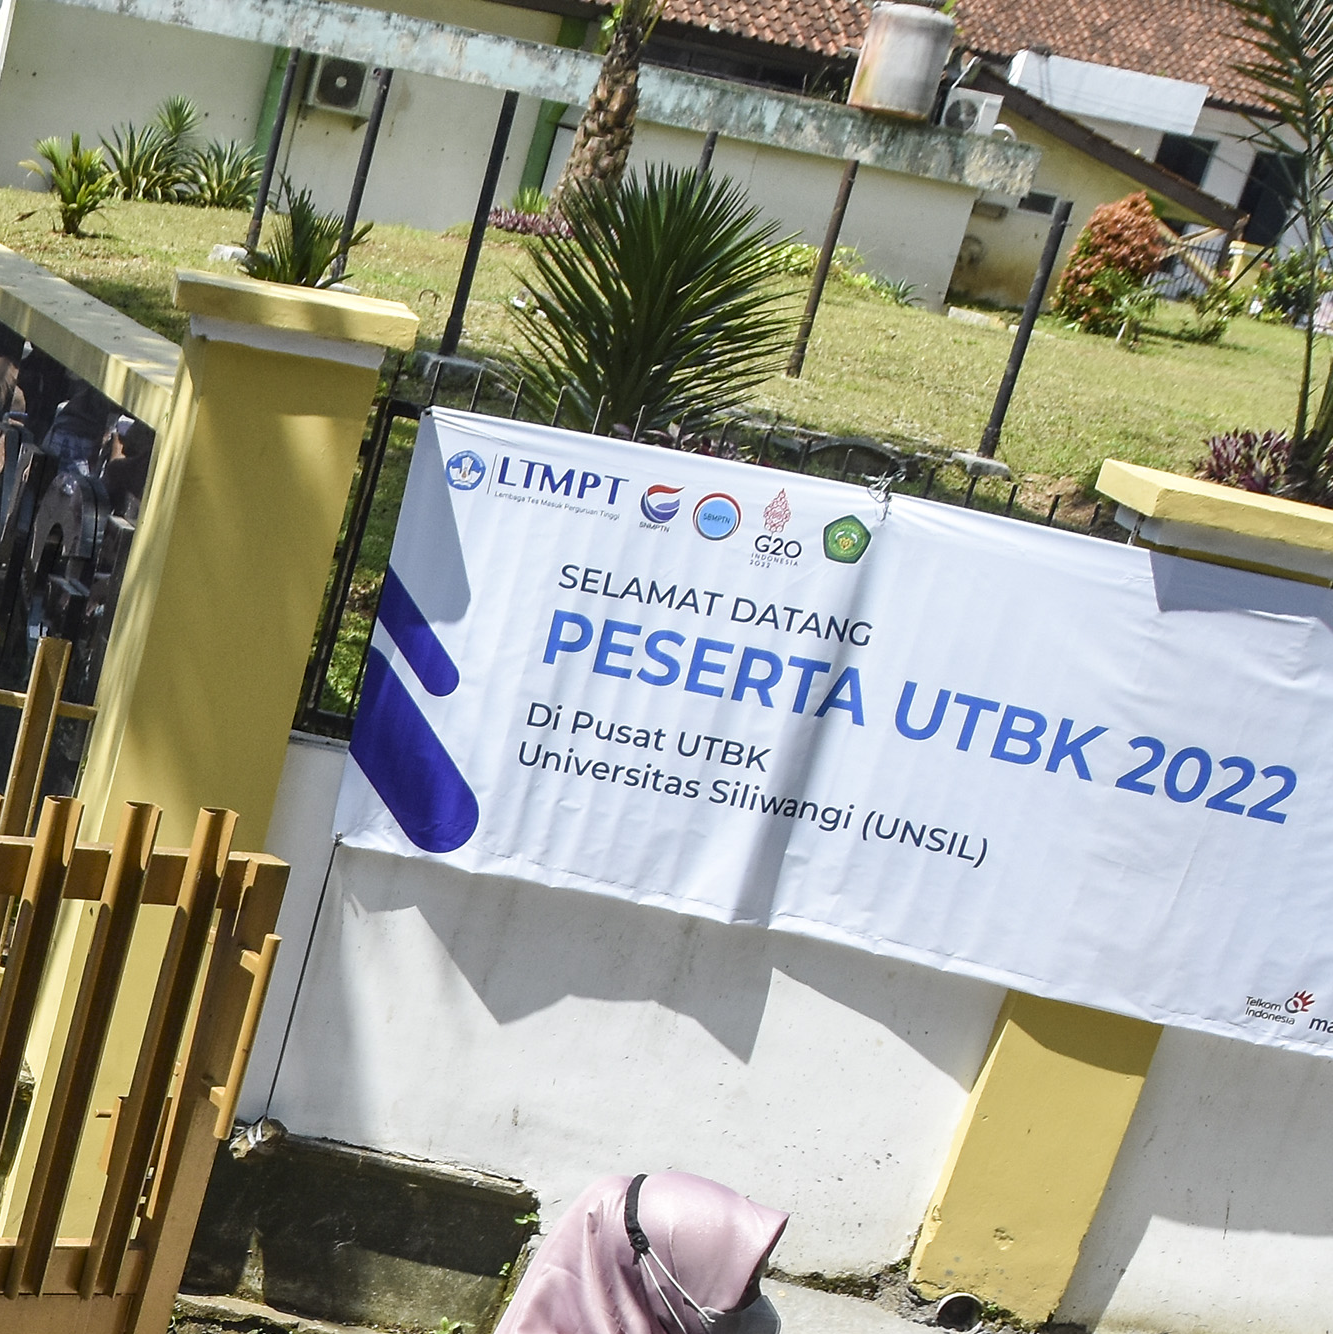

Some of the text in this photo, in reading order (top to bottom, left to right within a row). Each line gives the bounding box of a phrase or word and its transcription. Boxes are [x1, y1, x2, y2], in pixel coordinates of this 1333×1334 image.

[497, 456, 630, 505] LTMPT
[494, 490, 526, 503] Lembaga
[540, 498, 563, 509] Masuk
[564, 504, 599, 516] Perguruan
[600, 509, 621, 521] Tinggi
[639, 520, 670, 533] SNMPTN
[703, 512, 731, 525] SBMPTN
[754, 535, 802, 559] G20
[749, 559, 771, 569] 2022
[750, 552, 799, 567] INDONESIA
[558, 563, 874, 647] SELAMAT DATANG
[542, 608, 1298, 825] PESERTA UTBK 2022
[525, 701, 773, 774] Di Pusat UTBK
[516, 740, 989, 869] Universitas Siliwangi (UNSIL)
[1245, 995, 1282, 1012] Telkom
[1245, 1007, 1296, 1025] Indonesia
